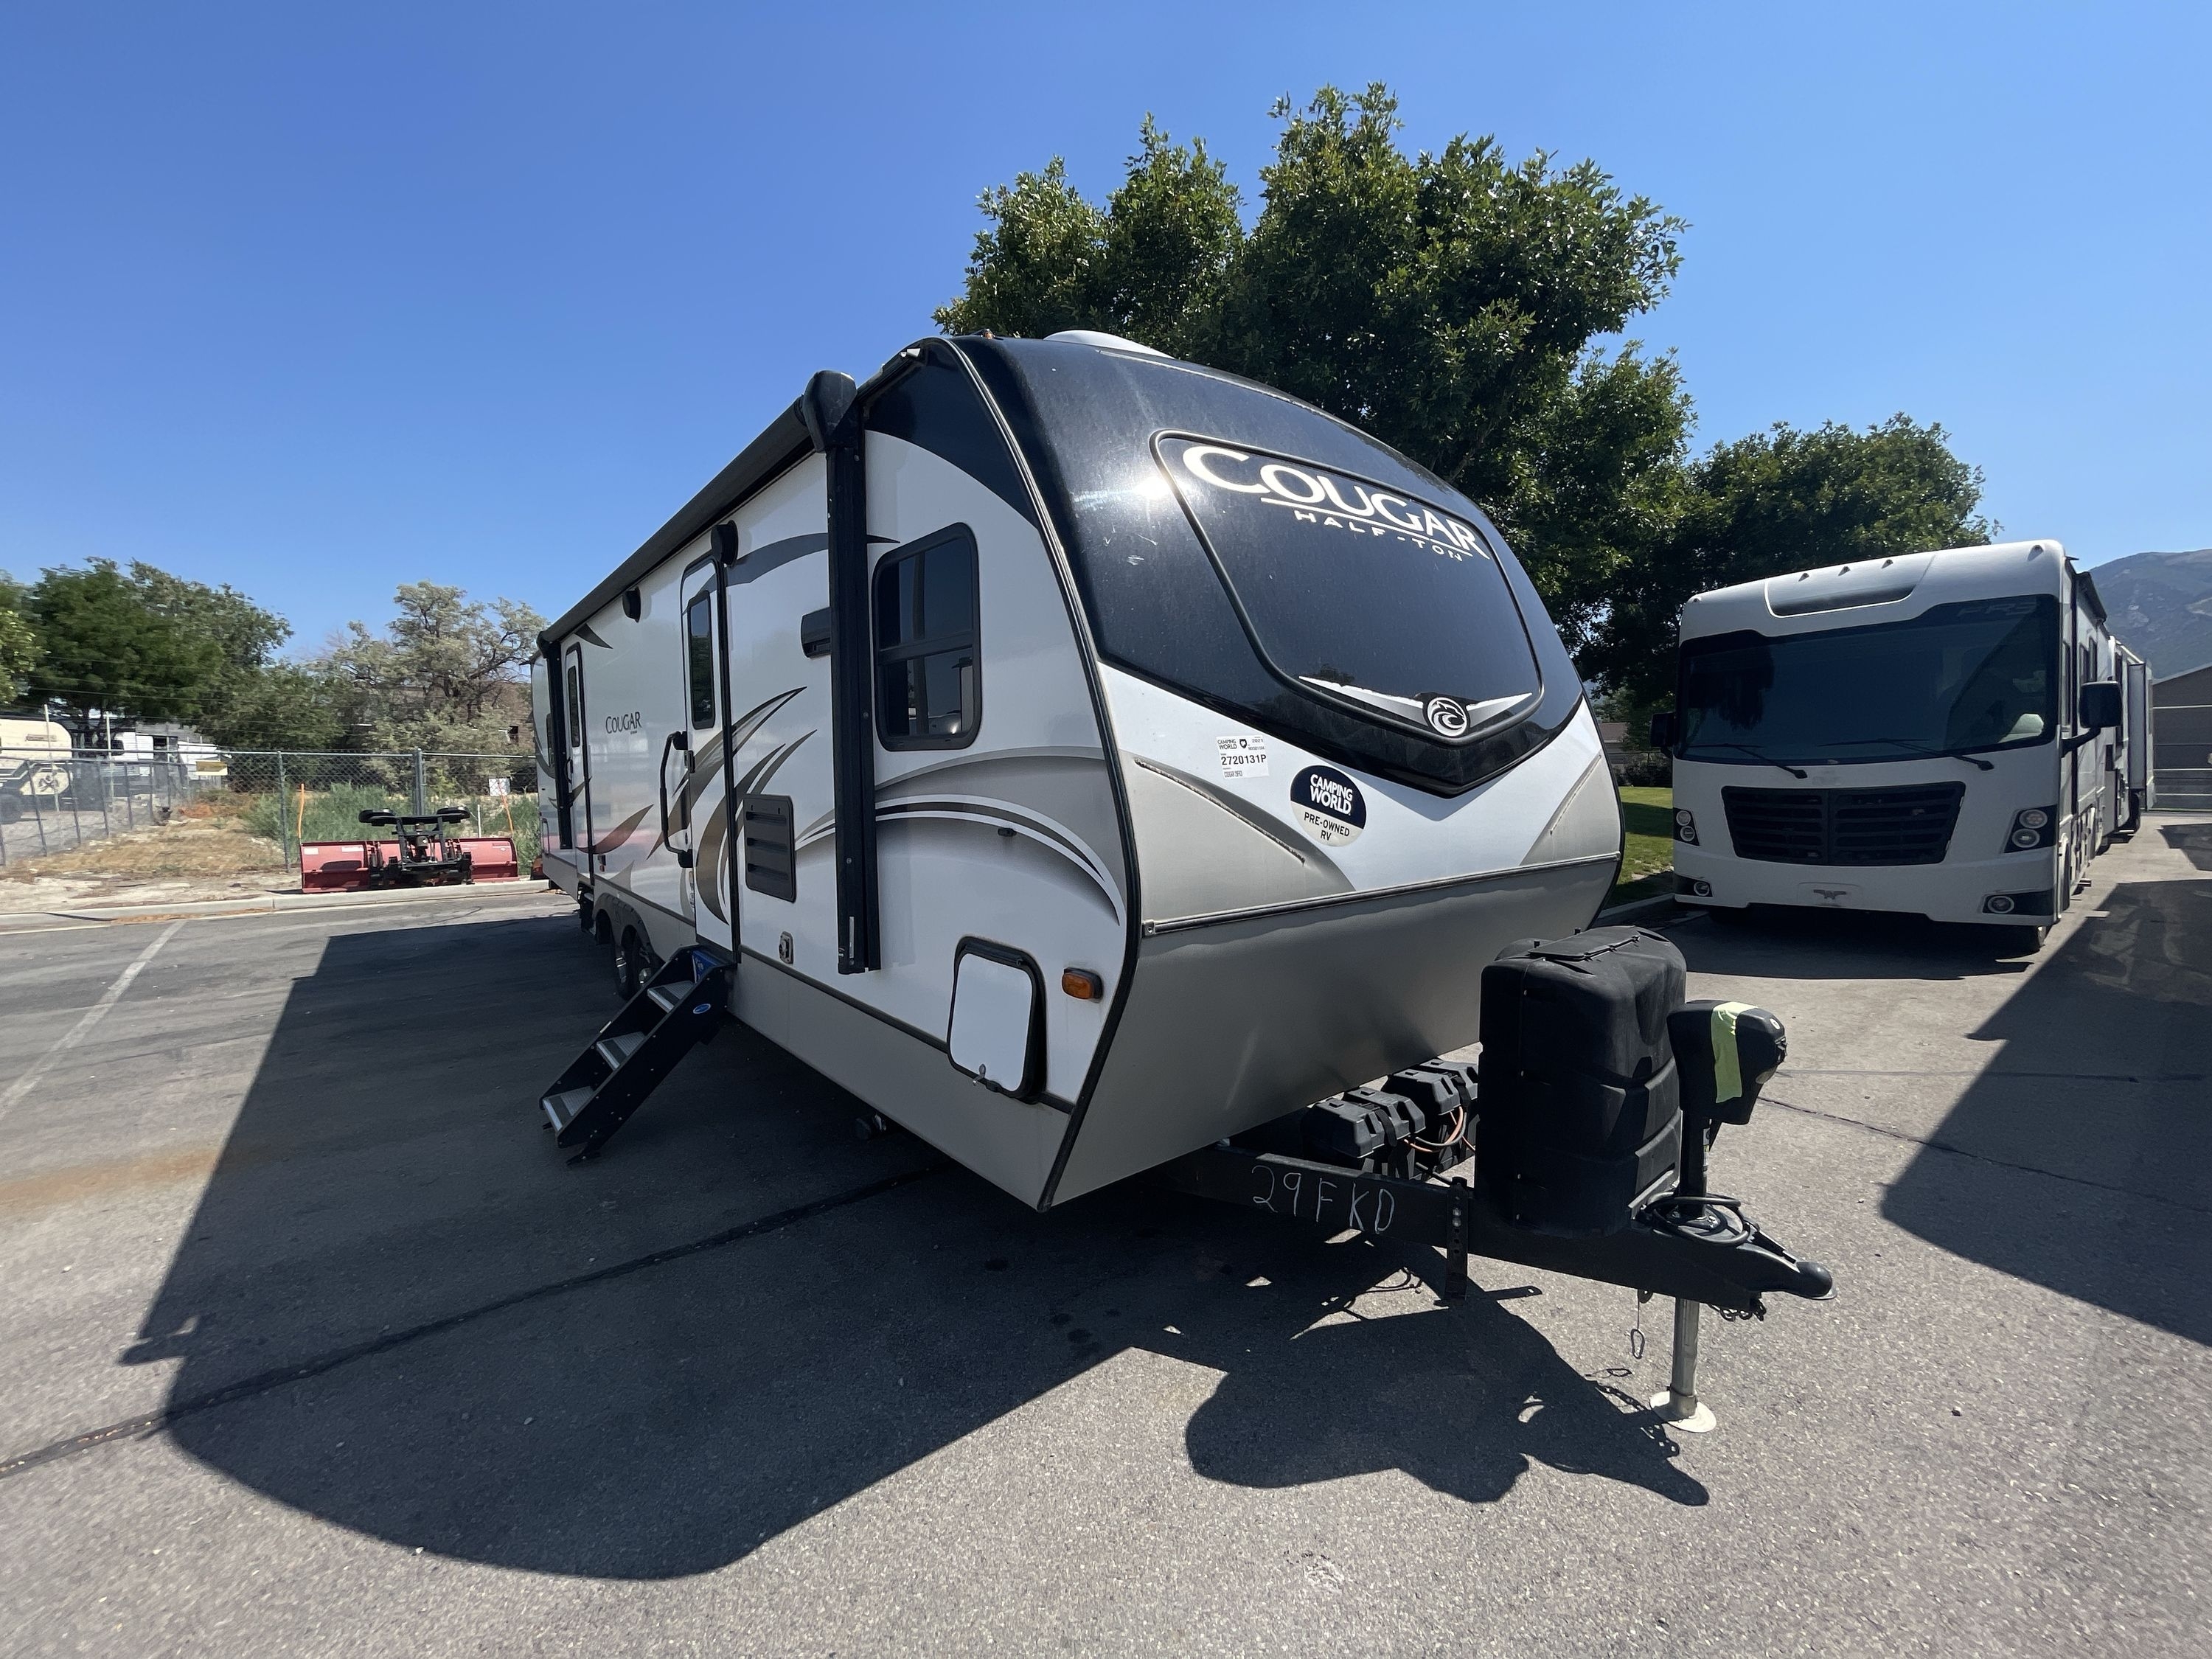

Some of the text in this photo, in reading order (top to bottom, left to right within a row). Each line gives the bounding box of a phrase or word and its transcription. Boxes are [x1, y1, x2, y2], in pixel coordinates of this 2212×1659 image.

[1183, 445, 1490, 560] COUGAR
[1294, 509, 1463, 562] HALF-TON
[605, 711, 642, 734] COUGAR
[1221, 754, 1267, 765] 2720131P
[1310, 773, 1353, 801] CAMPING
[1310, 785, 1352, 815] WORLD
[1304, 811, 1350, 837] PRE-OWNED
[1320, 830, 1332, 841] RV
